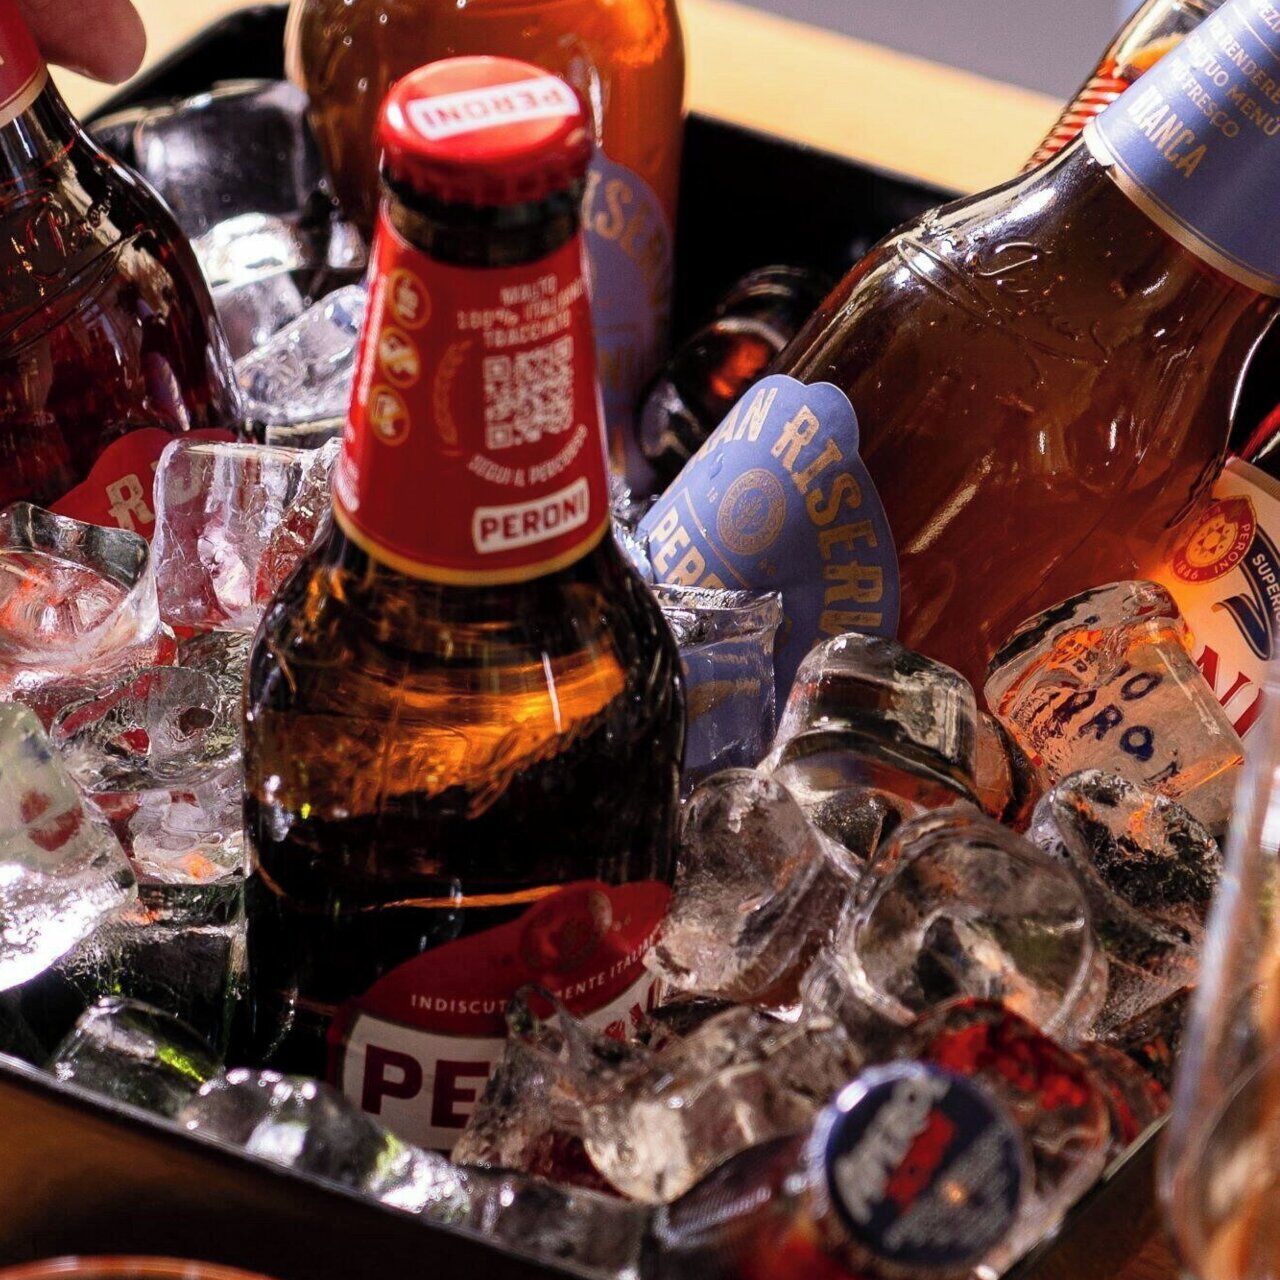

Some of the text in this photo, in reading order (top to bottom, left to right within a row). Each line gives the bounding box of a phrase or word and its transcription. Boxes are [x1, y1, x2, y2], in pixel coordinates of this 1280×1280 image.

[421, 84, 568, 128] PERONI
[1124, 84, 1209, 180] BIANCA
[1182, 76, 1241, 139] FRESCO
[479, 490, 587, 542] PERONI
[770, 404, 885, 637] RISERV
[649, 506, 725, 590] PER
[1174, 523, 1251, 581] 1846 PERONI
